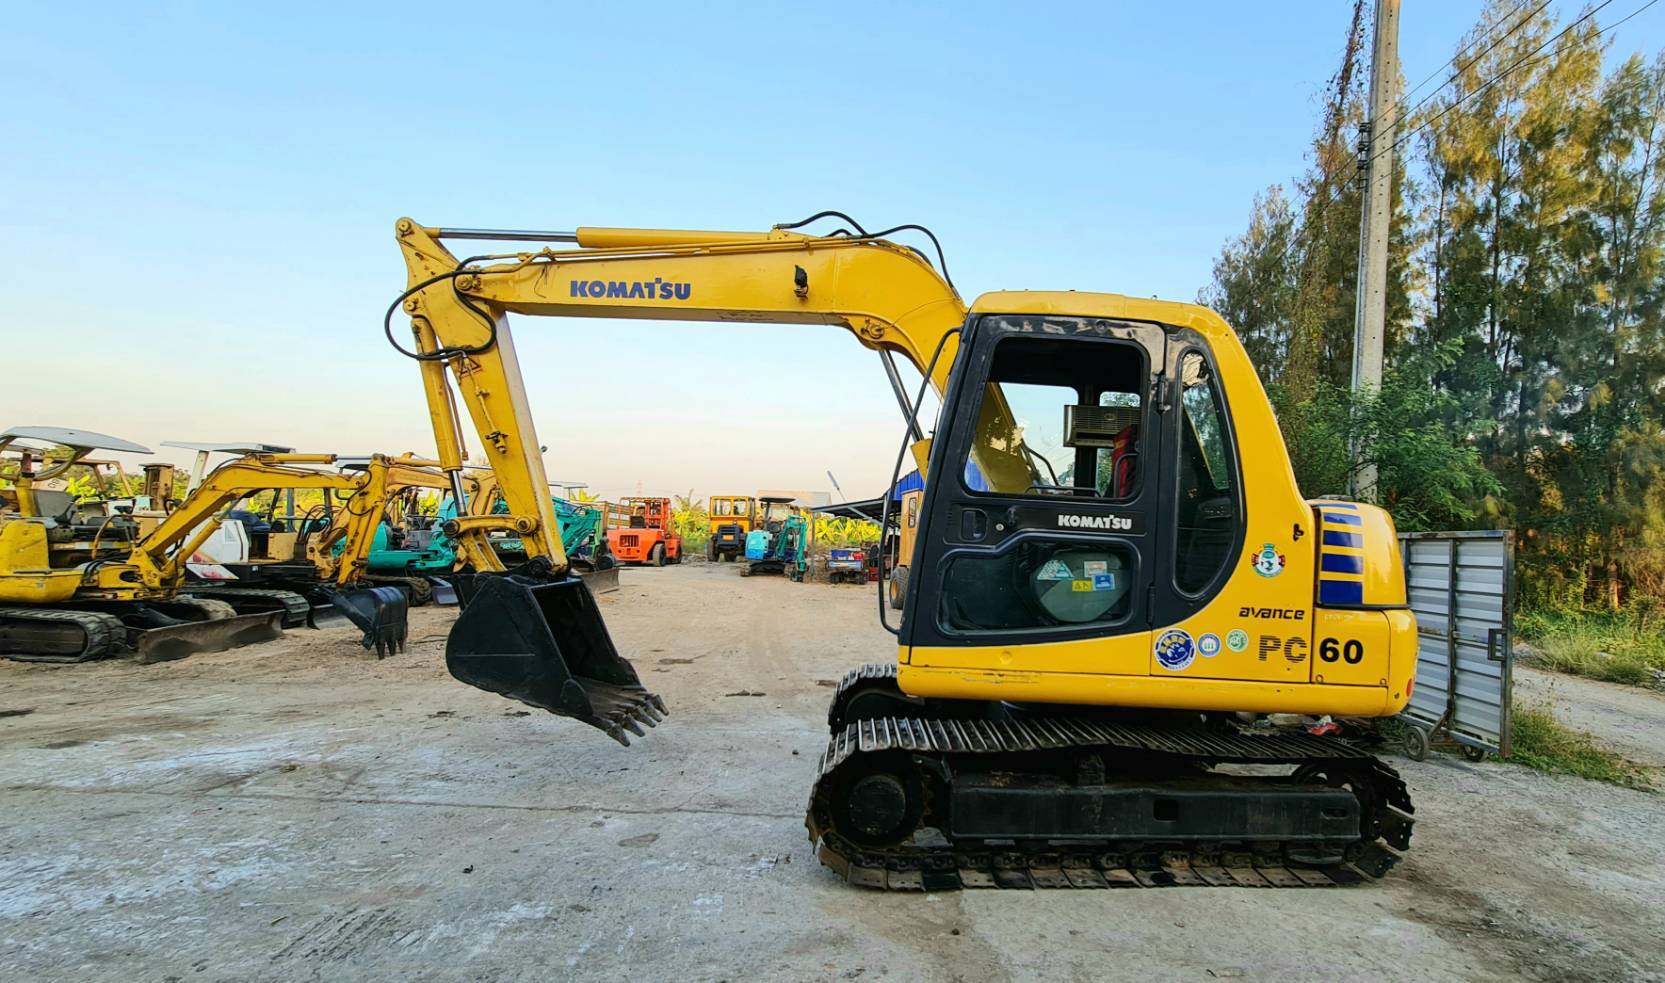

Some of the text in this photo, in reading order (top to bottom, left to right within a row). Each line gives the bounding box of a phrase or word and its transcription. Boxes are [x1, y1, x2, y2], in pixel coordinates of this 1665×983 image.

[570, 277, 691, 300] KOMATSU
[1057, 514, 1133, 530] KOMATSU
[1238, 606, 1305, 620] avance
[1258, 634, 1308, 664] PC
[1319, 636, 1364, 665] 60
